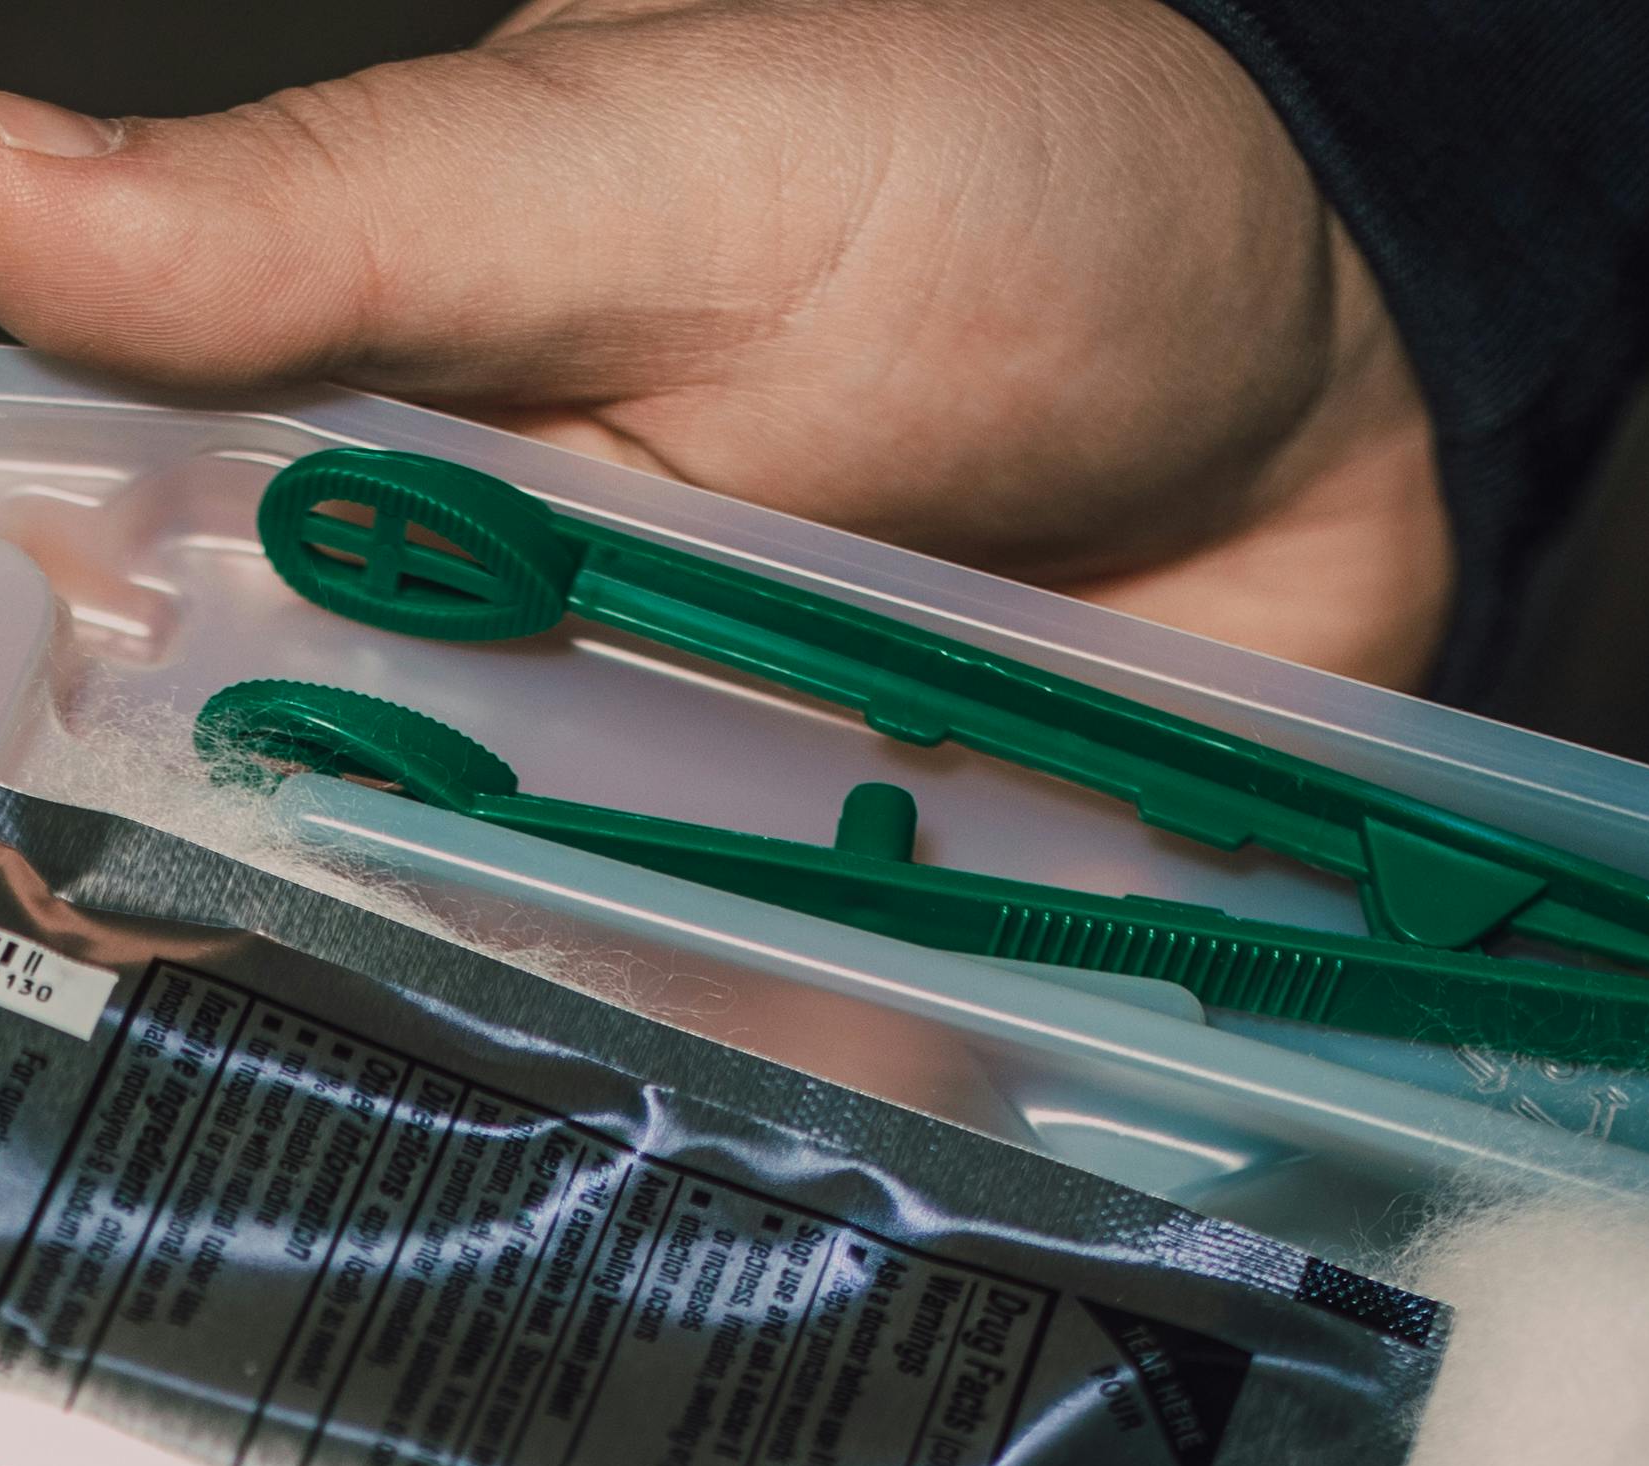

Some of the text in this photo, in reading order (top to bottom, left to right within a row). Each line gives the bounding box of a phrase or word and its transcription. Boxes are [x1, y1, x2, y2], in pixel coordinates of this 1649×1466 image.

[135, 974, 193, 1065] phosphate,
[174, 990, 233, 1080] Inactive
[245, 1036, 274, 1064] for
[8, 1048, 46, 1089] For
[278, 1050, 306, 1079] not
[83, 1061, 151, 1178] nonoxynol-9,
[210, 1060, 261, 1133] hospital
[255, 1079, 294, 1133] made
[109, 1077, 191, 1217] ingredients
[205, 1130, 229, 1154] or
[238, 1130, 273, 1173] with
[256, 1064, 343, 1229] 1% titratable iodine
[287, 1055, 394, 1262] Other information
[379, 1080, 451, 1202] Directions
[482, 1114, 538, 1200] ingestion,
[530, 1129, 576, 1185] Keep
[157, 1152, 220, 1262] professional
[213, 1171, 255, 1235] natural
[434, 1158, 479, 1224] control
[521, 1180, 553, 1216] out
[627, 1170, 667, 1225] Avoid
[88, 1216, 125, 1263] citric
[349, 1202, 391, 1255] apply
[411, 1220, 451, 1280] center
[466, 1198, 503, 1247] seek
[542, 1208, 597, 1297] excessive
[781, 1219, 822, 1268] Stop
[187, 1233, 228, 1292] rubber
[327, 1252, 371, 1309] locally
[489, 1237, 529, 1291] reach
[593, 1222, 645, 1296] pooling
[633, 1214, 704, 1344] infection occurs
[680, 1228, 738, 1335] or increases
[724, 1238, 773, 1314] redness,
[773, 1267, 804, 1306] use
[873, 1255, 908, 1296] Ask
[425, 1244, 481, 1341] professional
[480, 1287, 509, 1313] of
[523, 1294, 562, 1344] heat.
[868, 1288, 891, 1307] a
[966, 1284, 1026, 1361] Drug
[571, 1292, 618, 1364] beneath
[697, 1312, 745, 1386] irritation,
[759, 1305, 790, 1343] and
[817, 1313, 841, 1337] or
[848, 1305, 889, 1366] doctor
[892, 1269, 959, 1380] Warnings
[745, 1338, 777, 1377] ask
[787, 1330, 834, 1403] puncture
[1124, 1321, 1203, 1452] TEAR HERE
[718, 1385, 758, 1446] doctor
[825, 1363, 866, 1421] before
[945, 1356, 1001, 1438] Facts
[1092, 1360, 1146, 1435] POUR
[812, 1416, 843, 1451] use
